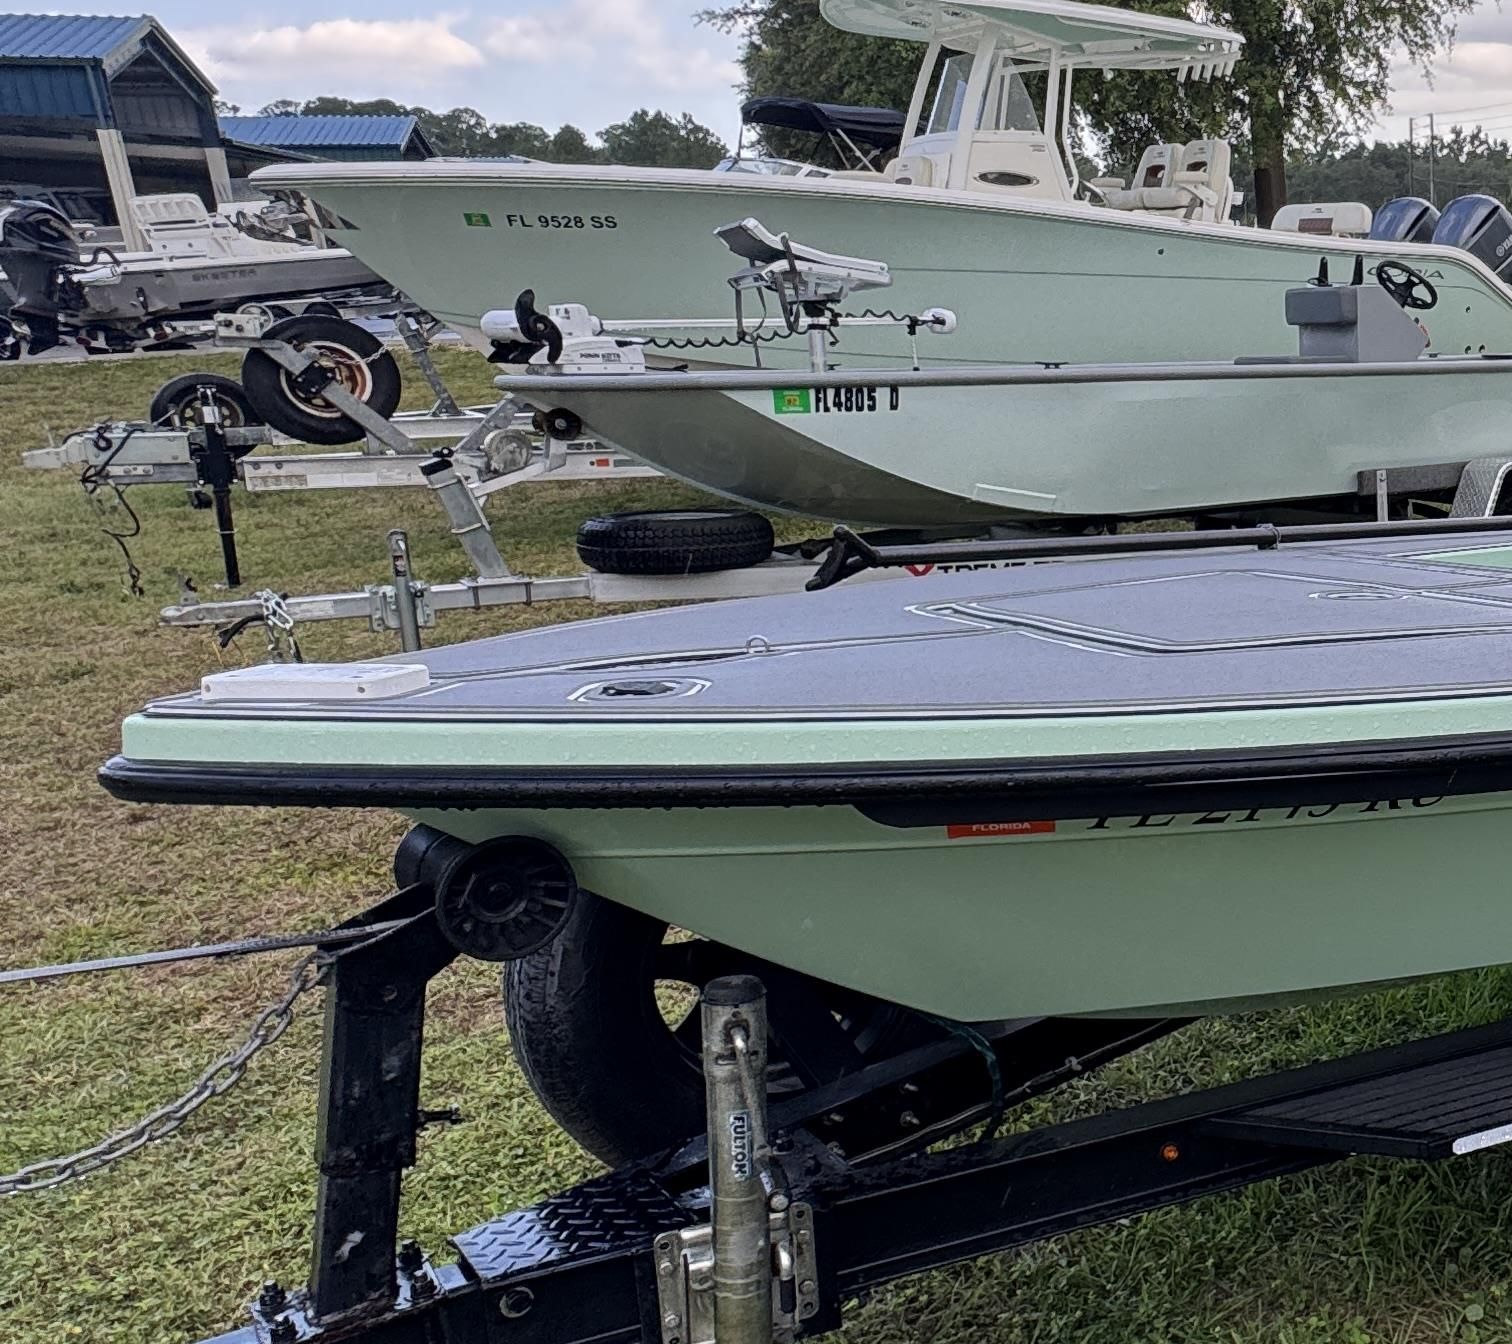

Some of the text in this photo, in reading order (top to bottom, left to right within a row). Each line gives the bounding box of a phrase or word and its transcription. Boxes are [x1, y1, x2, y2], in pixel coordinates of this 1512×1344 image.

[506, 214, 618, 229] FL 9528 SS
[889, 386, 900, 411] D
[971, 822, 1032, 832] FLORIDA
[733, 1116, 747, 1175] FULTON
